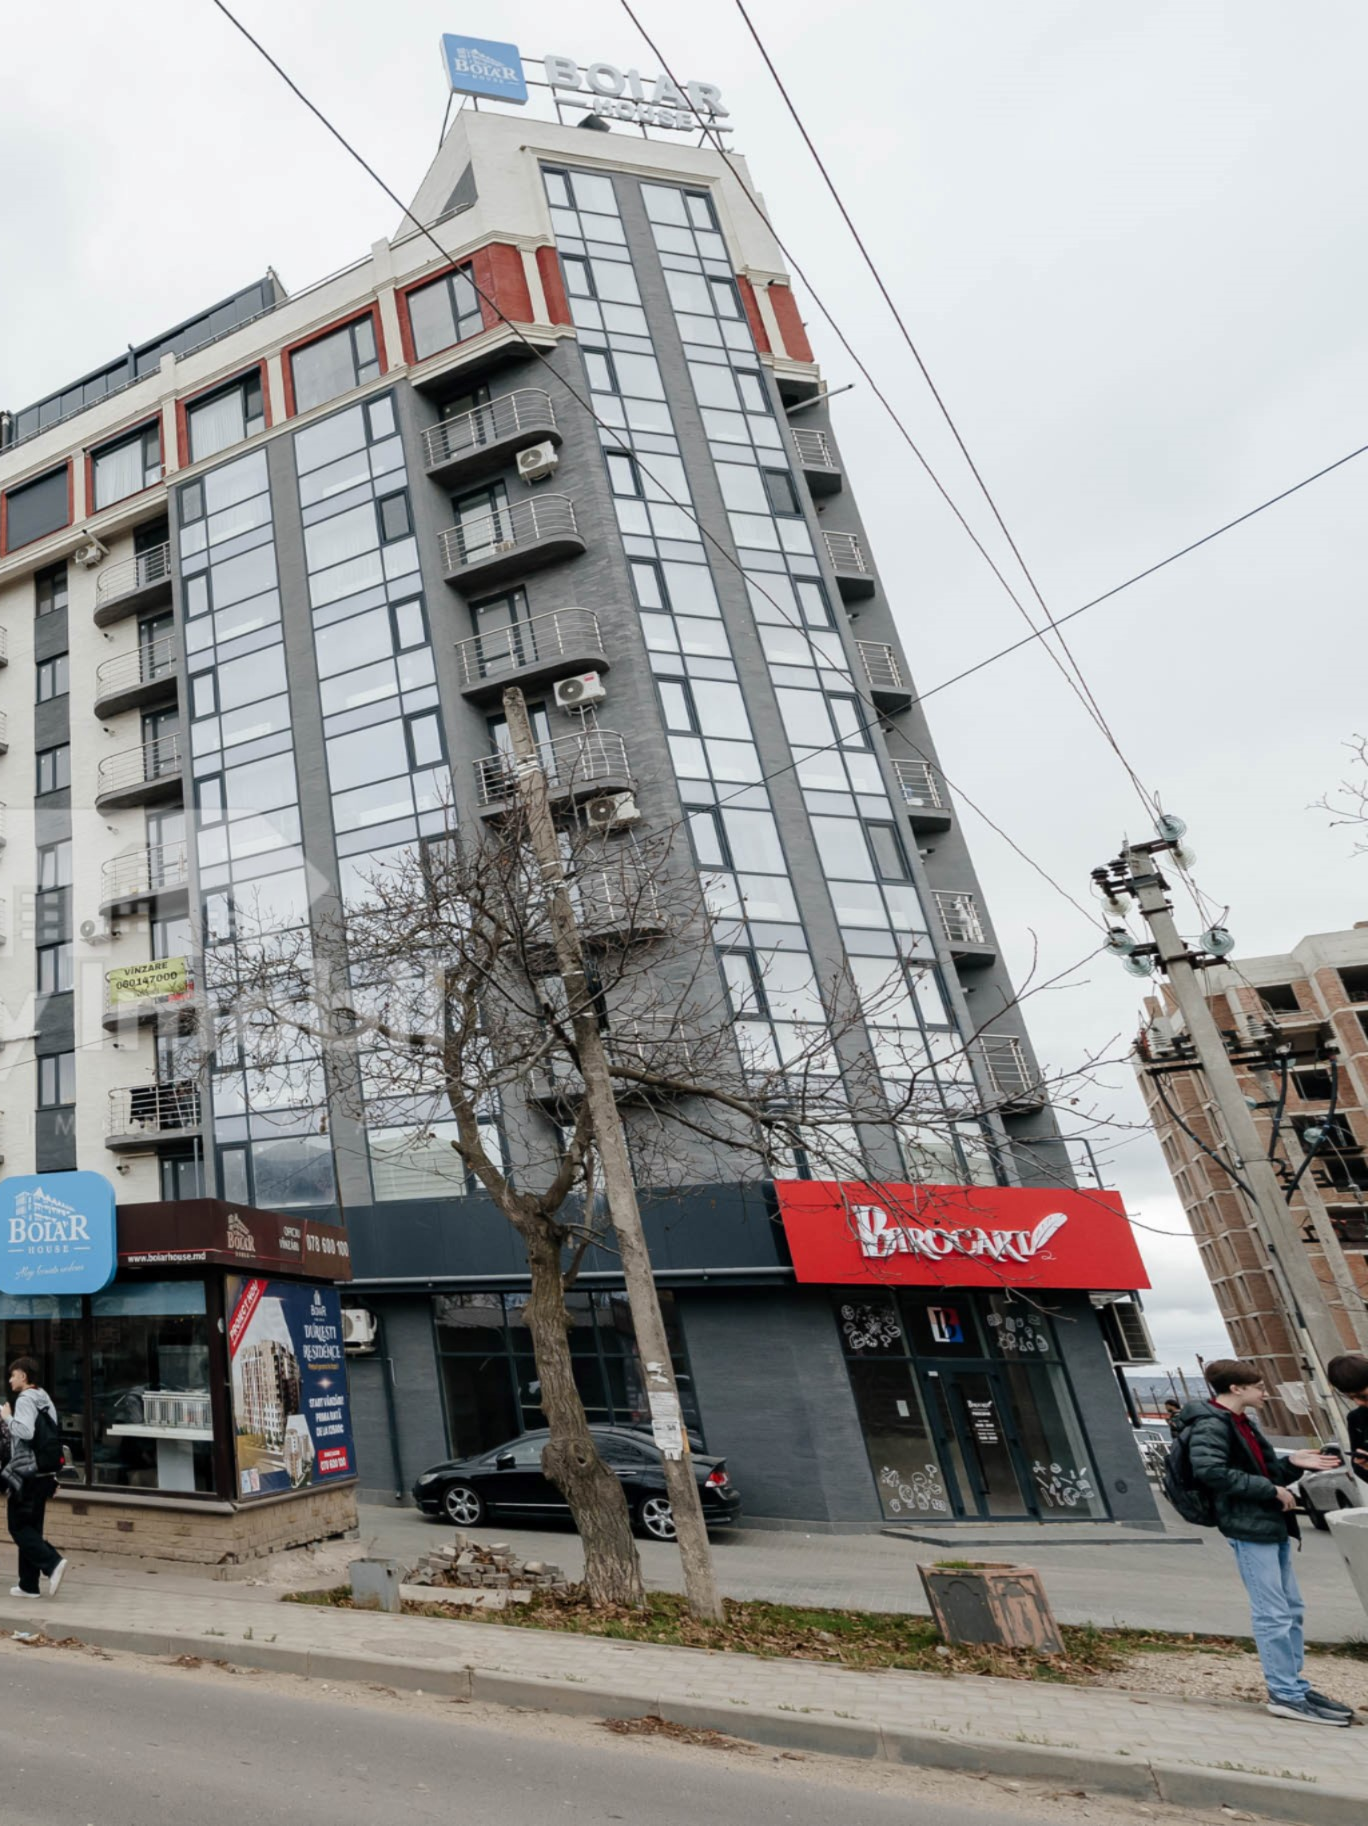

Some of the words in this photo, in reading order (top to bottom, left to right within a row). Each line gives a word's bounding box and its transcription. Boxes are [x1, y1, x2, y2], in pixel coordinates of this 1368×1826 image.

[454, 57, 520, 82] BOIAR
[544, 54, 730, 118] BOIAR
[592, 98, 696, 132] HOUSE
[115, 971, 179, 990] 060147000
[8, 1214, 91, 1243] BOIAR
[28, 1245, 70, 1254] HOUSE
[226, 1231, 256, 1252] BOIAR
[127, 1251, 207, 1263] www.boiarhouse.md
